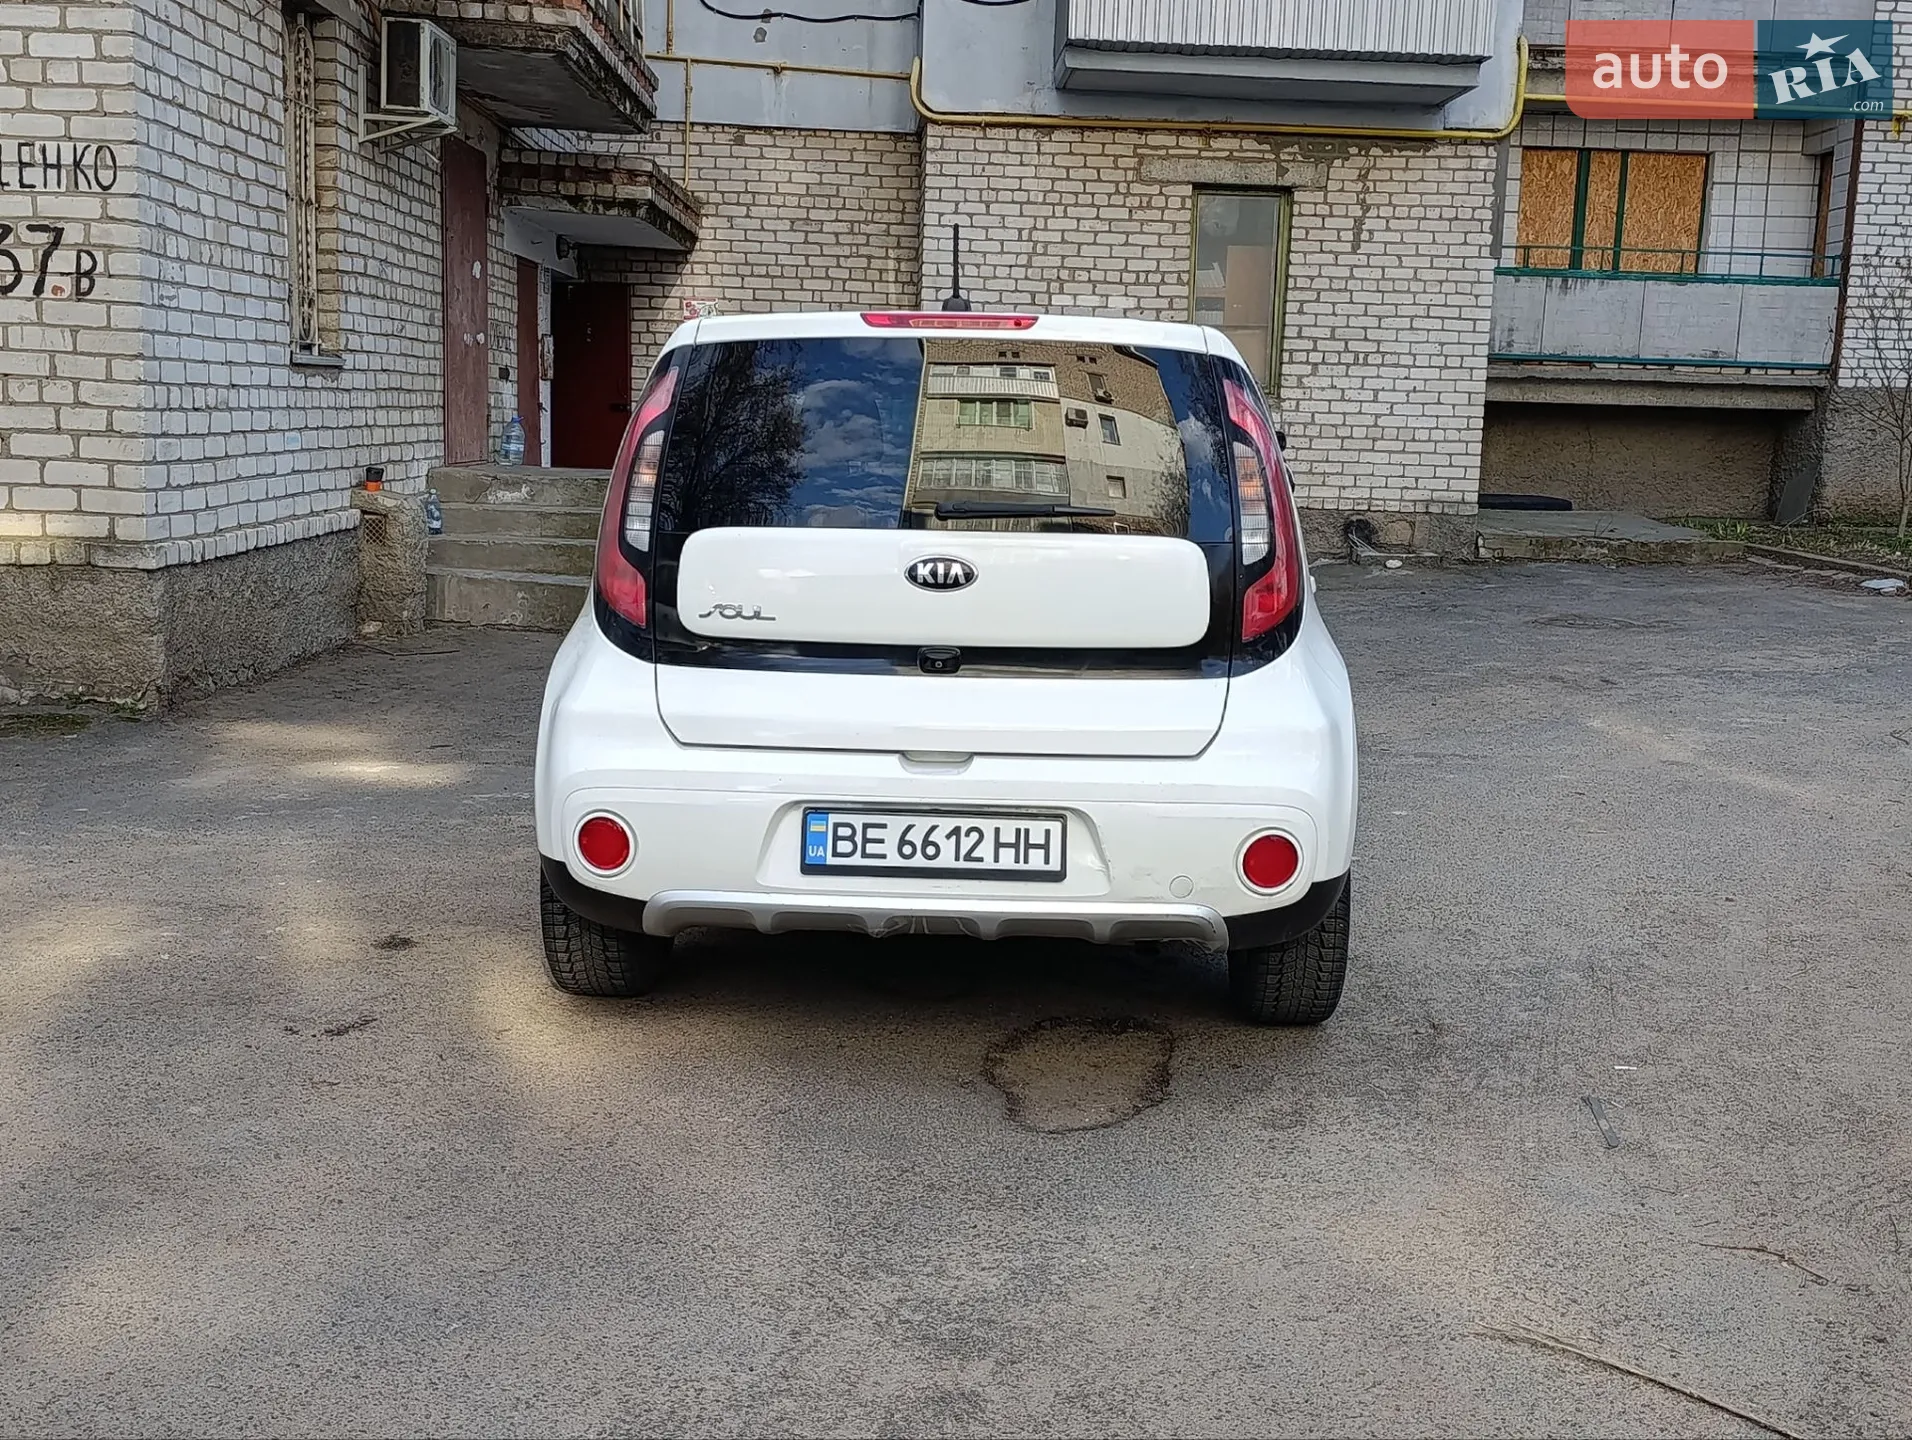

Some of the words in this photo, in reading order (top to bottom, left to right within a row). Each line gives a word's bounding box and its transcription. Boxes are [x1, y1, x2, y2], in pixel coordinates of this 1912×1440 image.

[0, 142, 117, 191] ЕНКО
[916, 562, 966, 584] KIA
[808, 844, 825, 857] UA
[897, 823, 985, 863] 6612
